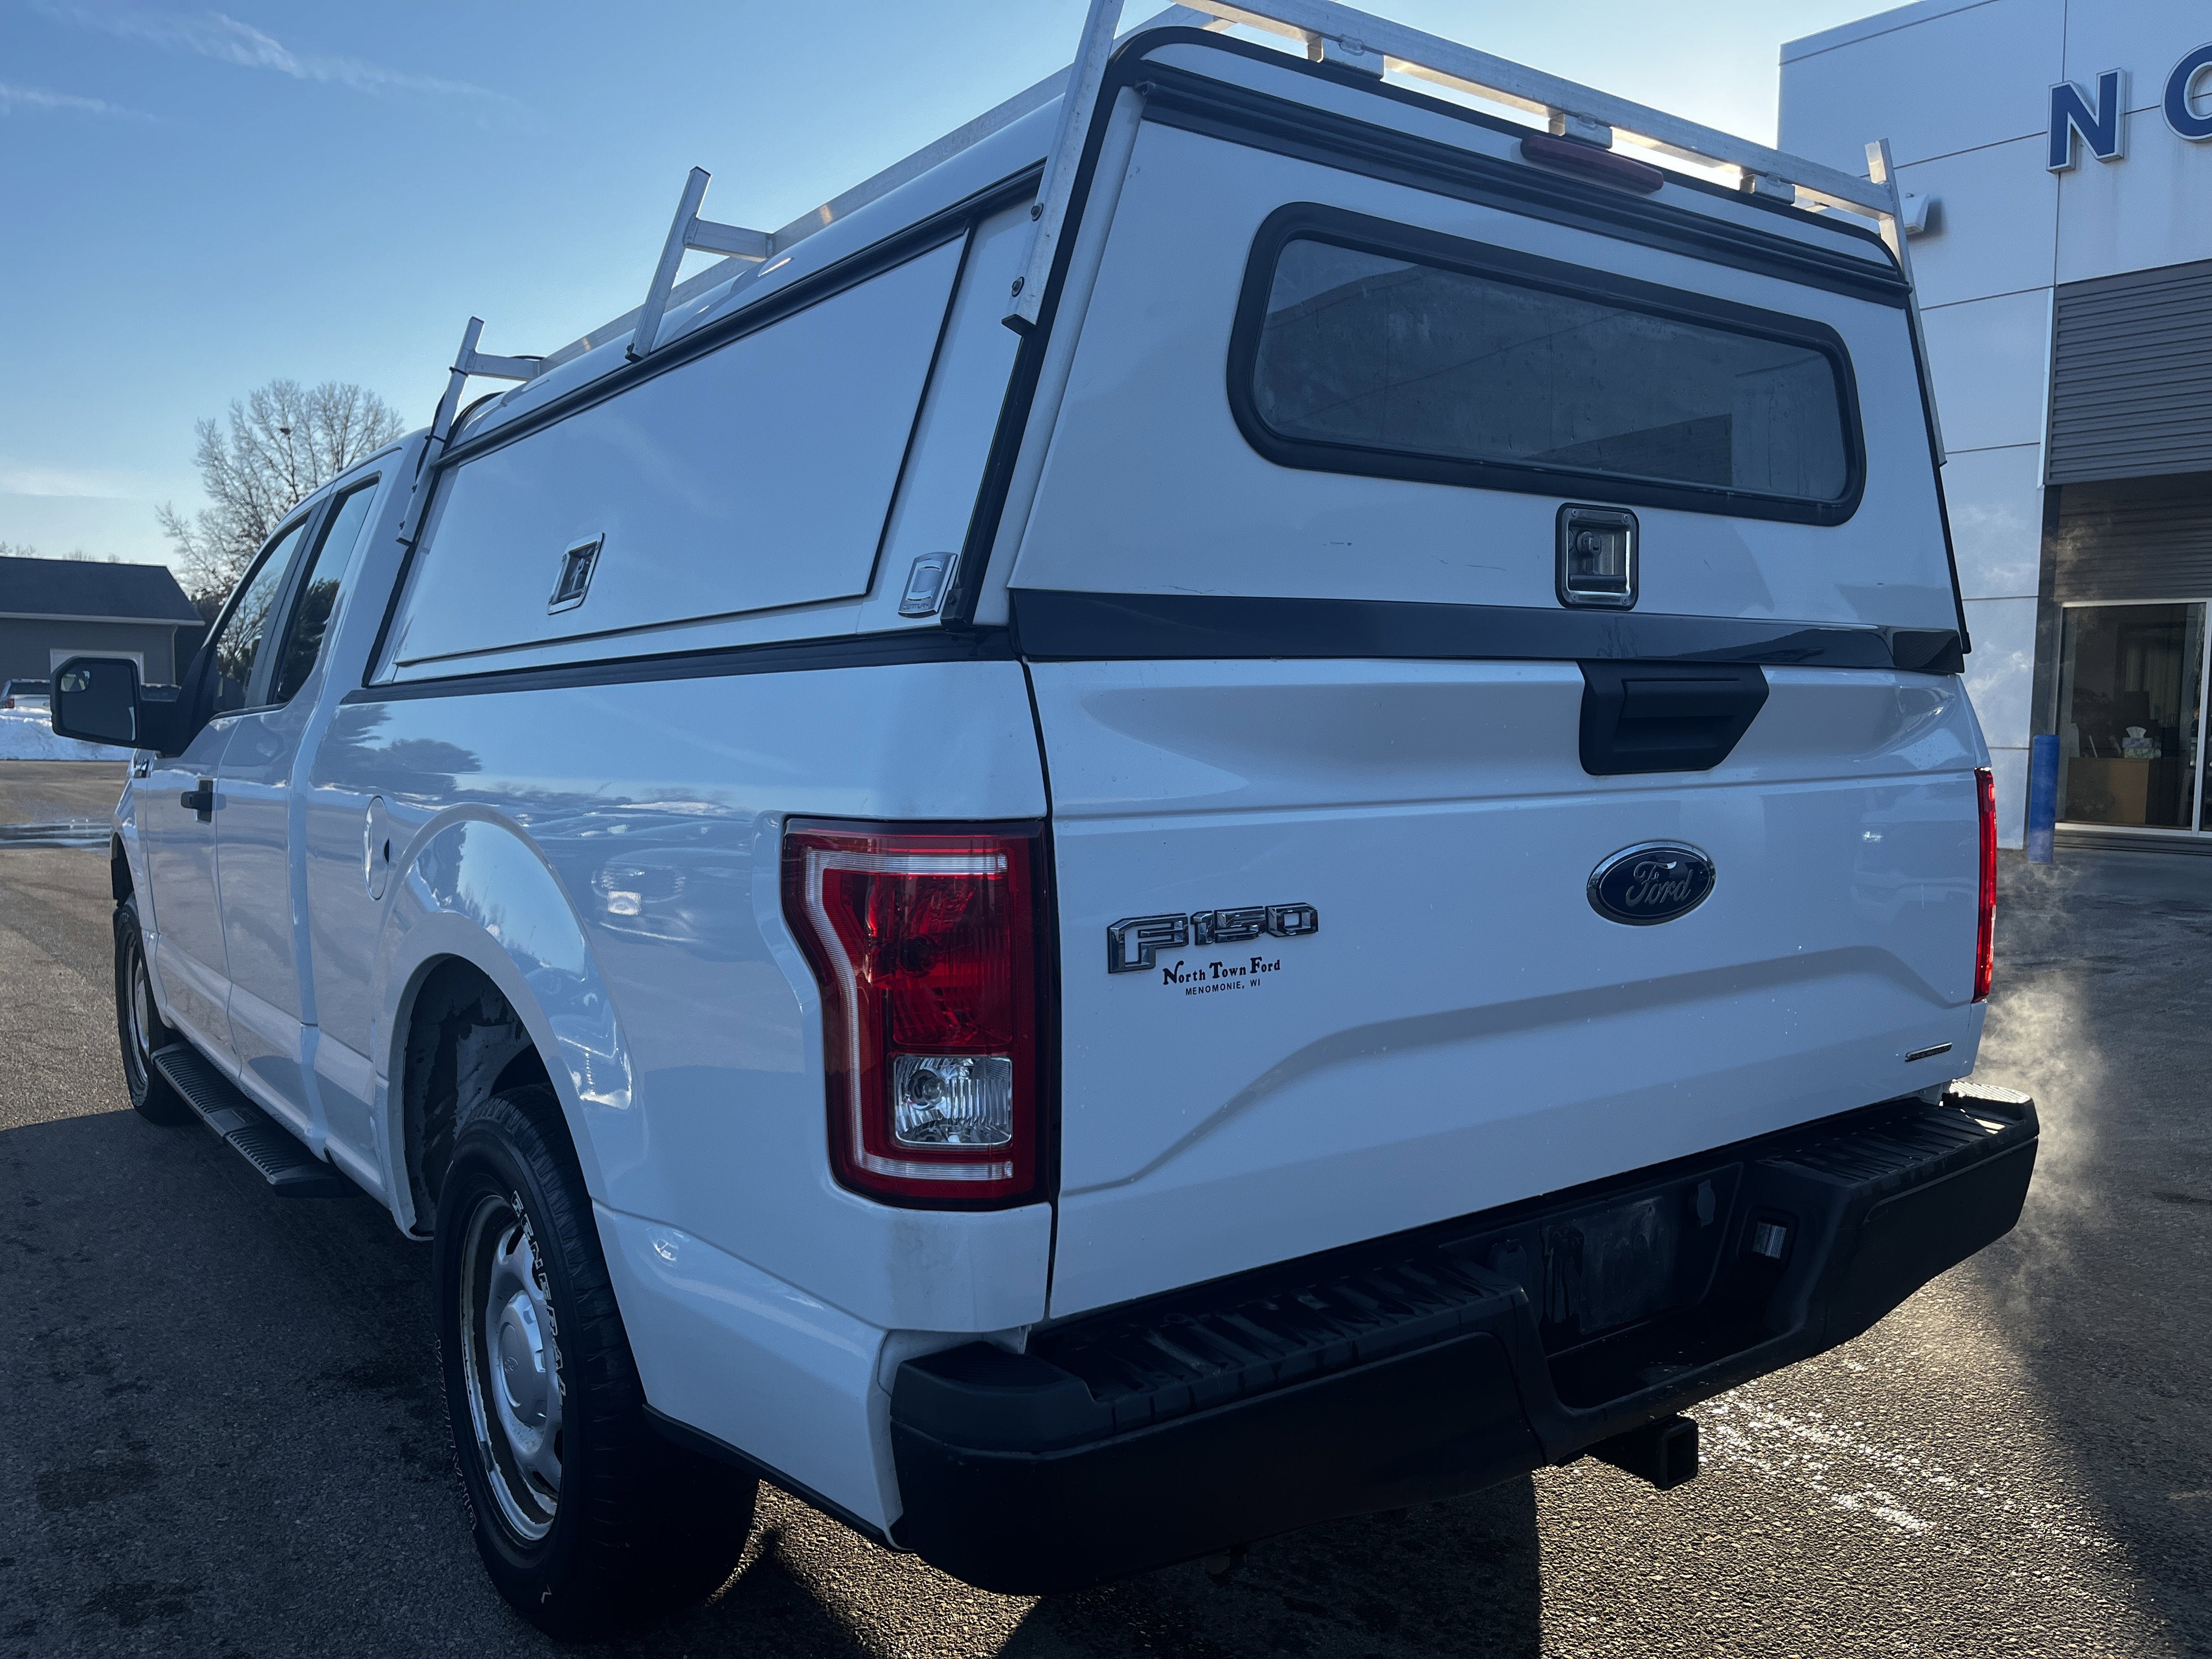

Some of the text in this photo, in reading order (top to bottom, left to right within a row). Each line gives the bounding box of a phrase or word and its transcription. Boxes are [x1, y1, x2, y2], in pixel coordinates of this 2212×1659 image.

[1625, 860, 1694, 909] Ford
[1163, 956, 1281, 985] North Town Ford
[1186, 978, 1261, 996] MENOMONIE, WI
